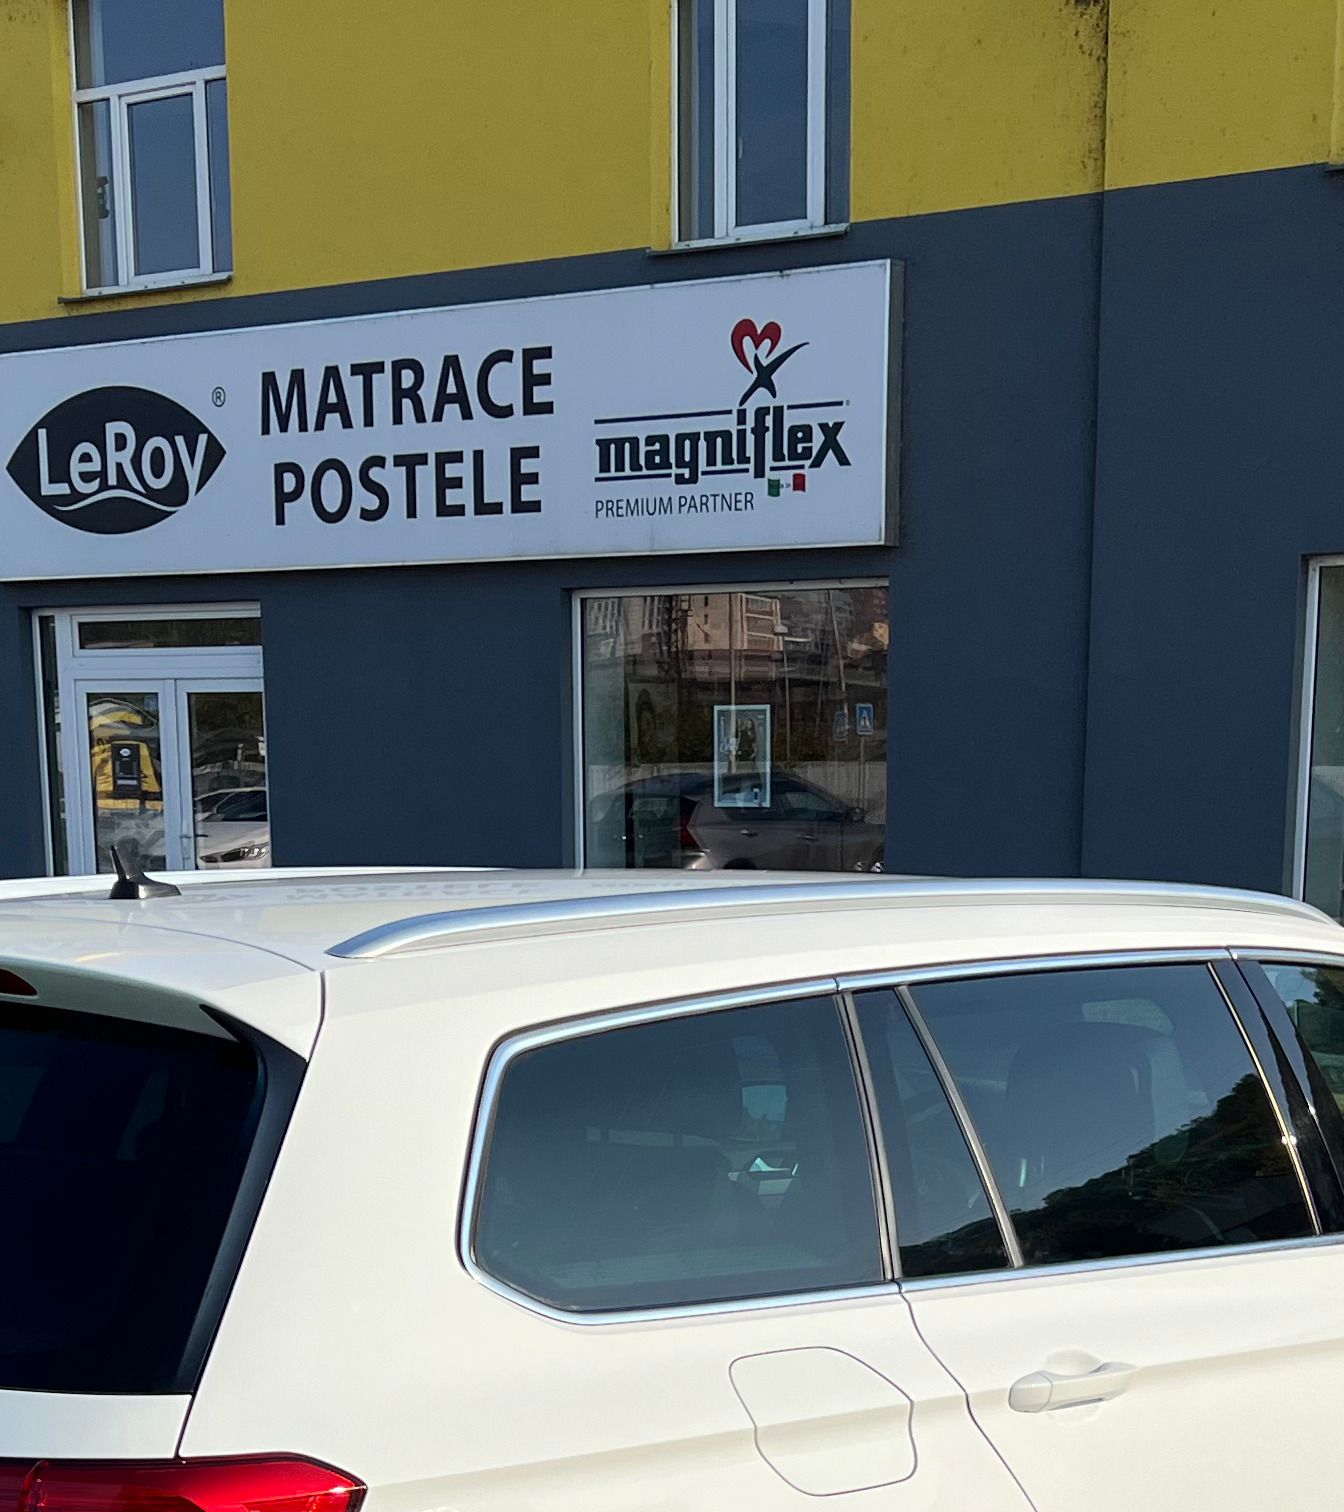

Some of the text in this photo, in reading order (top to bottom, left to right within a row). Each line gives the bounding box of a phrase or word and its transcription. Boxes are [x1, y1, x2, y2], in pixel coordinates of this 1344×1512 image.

[260, 346, 553, 436] MATRACE
[37, 421, 208, 500] LeRoy
[595, 405, 851, 485] magniflex
[273, 445, 542, 527] POSTELE
[595, 492, 755, 519] PREMIUM PARTNER
